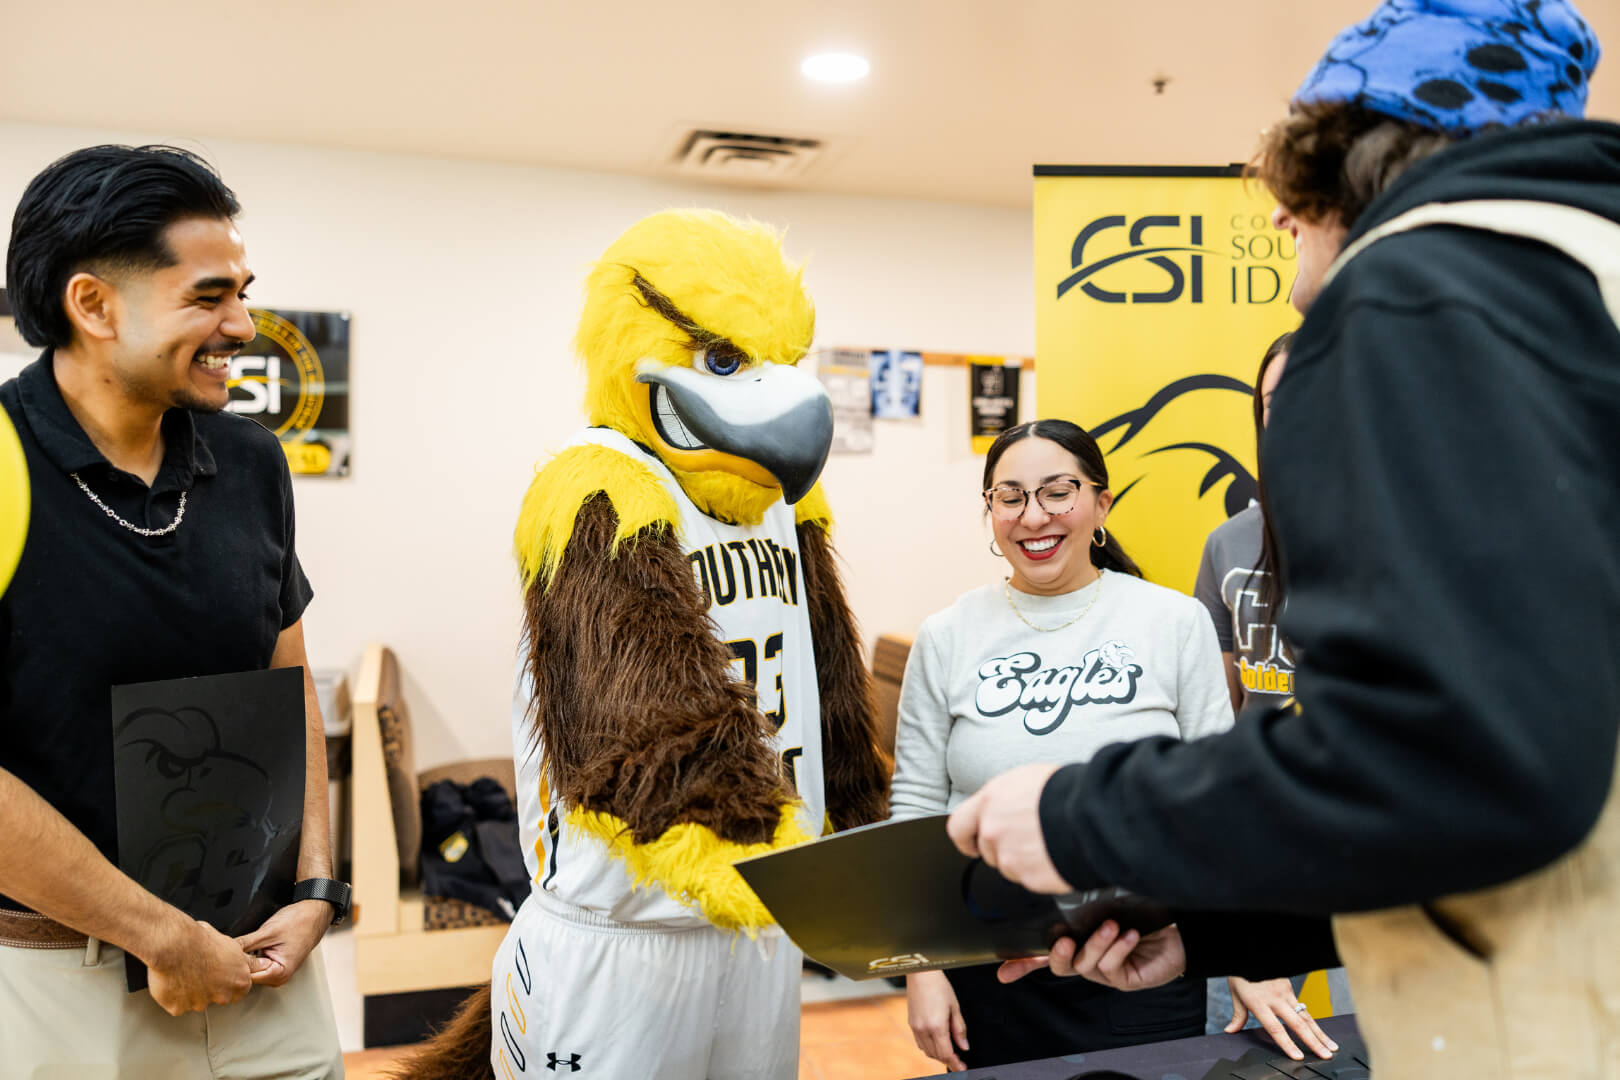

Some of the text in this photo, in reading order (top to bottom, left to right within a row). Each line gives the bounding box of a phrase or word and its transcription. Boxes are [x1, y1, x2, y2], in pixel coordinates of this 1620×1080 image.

[1068, 215, 1203, 304] CSI
[1231, 234, 1297, 260] SOU
[228, 355, 281, 415] SI
[975, 648, 1143, 736] Eagles
[869, 954, 928, 969] CSI
